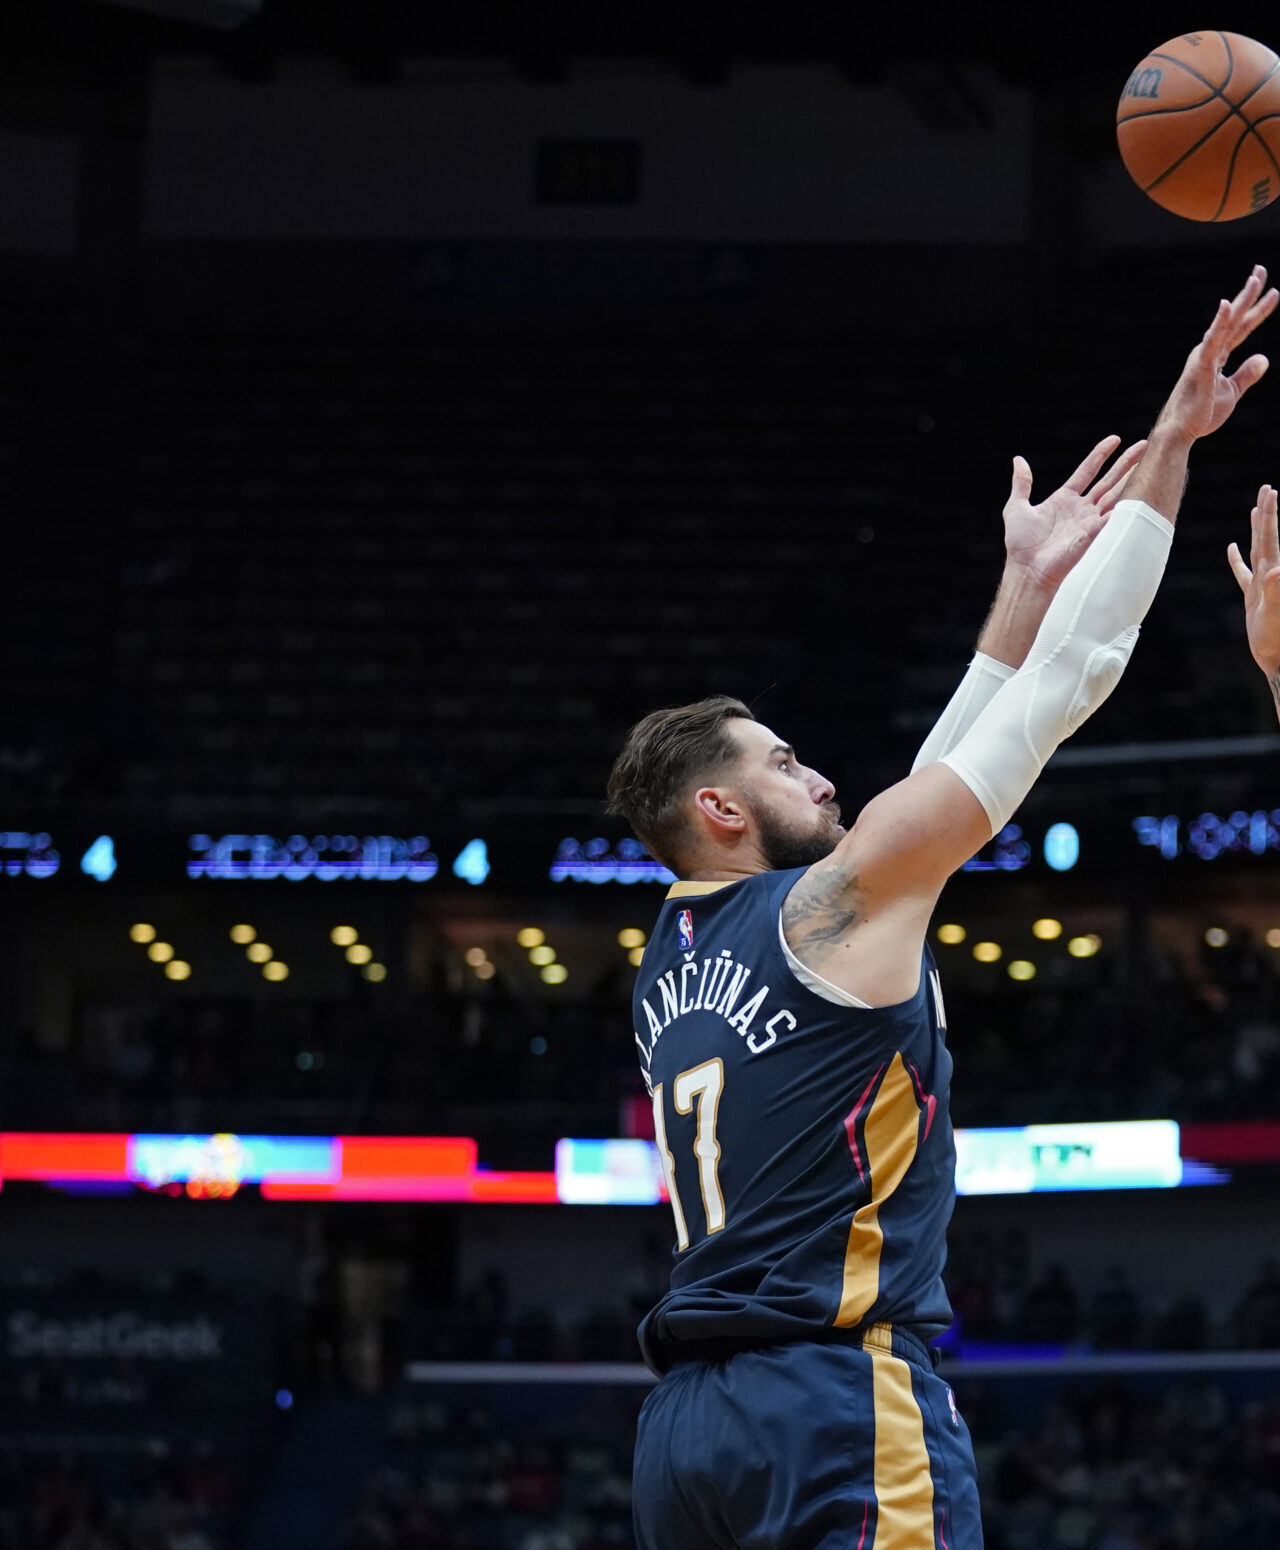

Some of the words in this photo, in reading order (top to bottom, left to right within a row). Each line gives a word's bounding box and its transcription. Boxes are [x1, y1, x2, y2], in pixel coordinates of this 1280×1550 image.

[81, 834, 118, 882] 4
[453, 838, 490, 885] 4
[634, 949, 797, 1098] ALANČIŪNAS
[652, 1056, 726, 1252] 17
